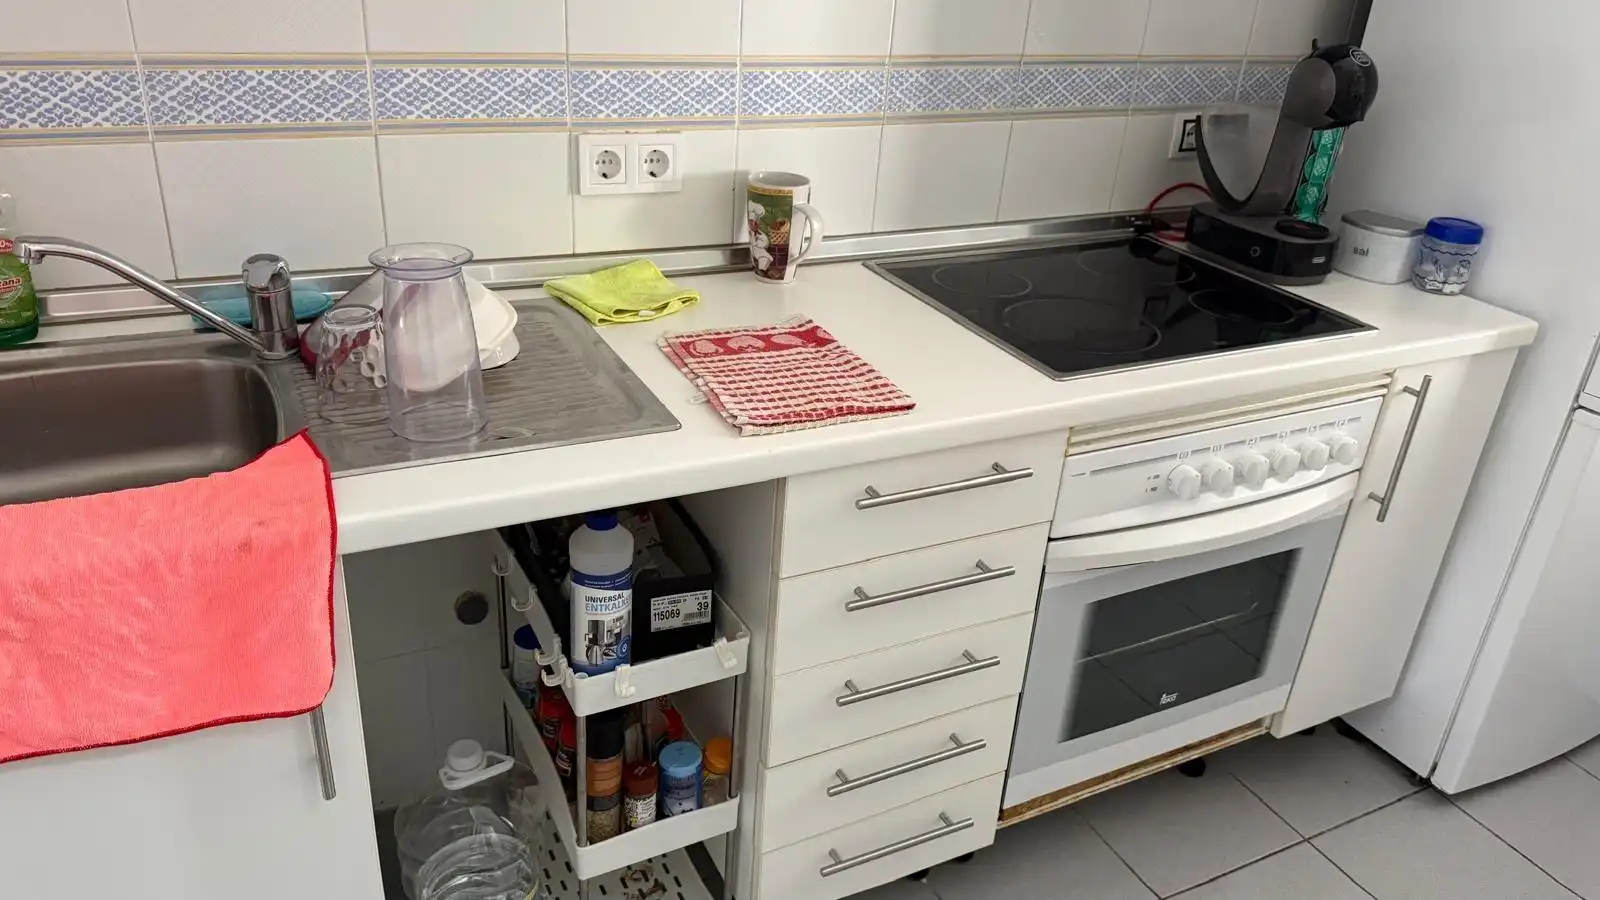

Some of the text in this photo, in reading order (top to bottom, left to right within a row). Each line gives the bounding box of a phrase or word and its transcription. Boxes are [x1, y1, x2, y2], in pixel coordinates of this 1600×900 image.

[1352, 246, 1369, 257] sal
[585, 592, 624, 603] UNIVERSAL
[696, 601, 709, 611] 39
[653, 608, 680, 621] 115069
